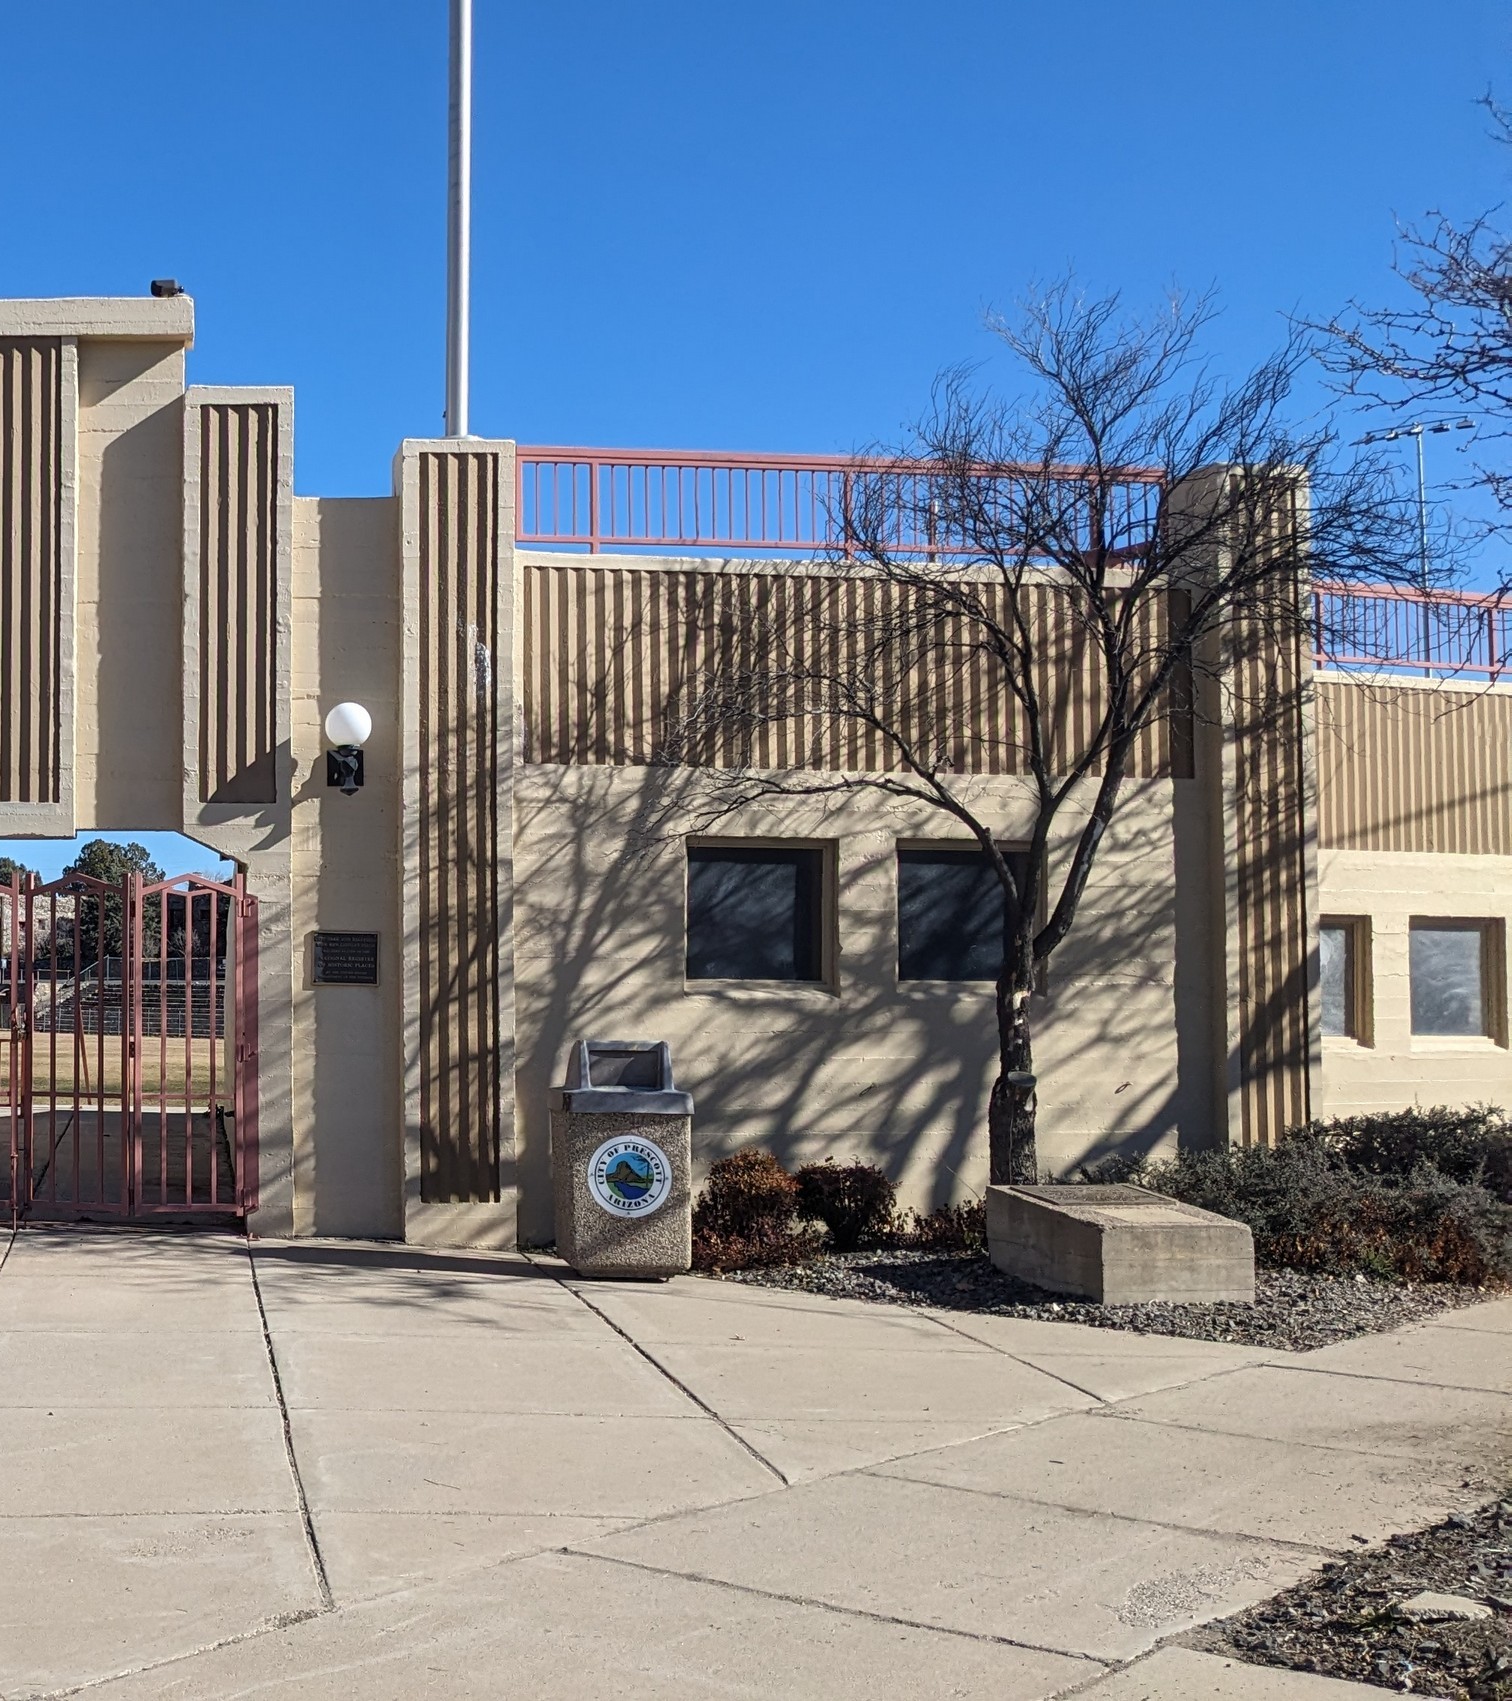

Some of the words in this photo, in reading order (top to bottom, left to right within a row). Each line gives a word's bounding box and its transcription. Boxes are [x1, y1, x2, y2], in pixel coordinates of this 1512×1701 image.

[597, 1159, 607, 1184] CITY
[607, 1147, 620, 1158] OF
[624, 1144, 662, 1185] PRESCOTT
[606, 1193, 656, 1208] ARIZONA
